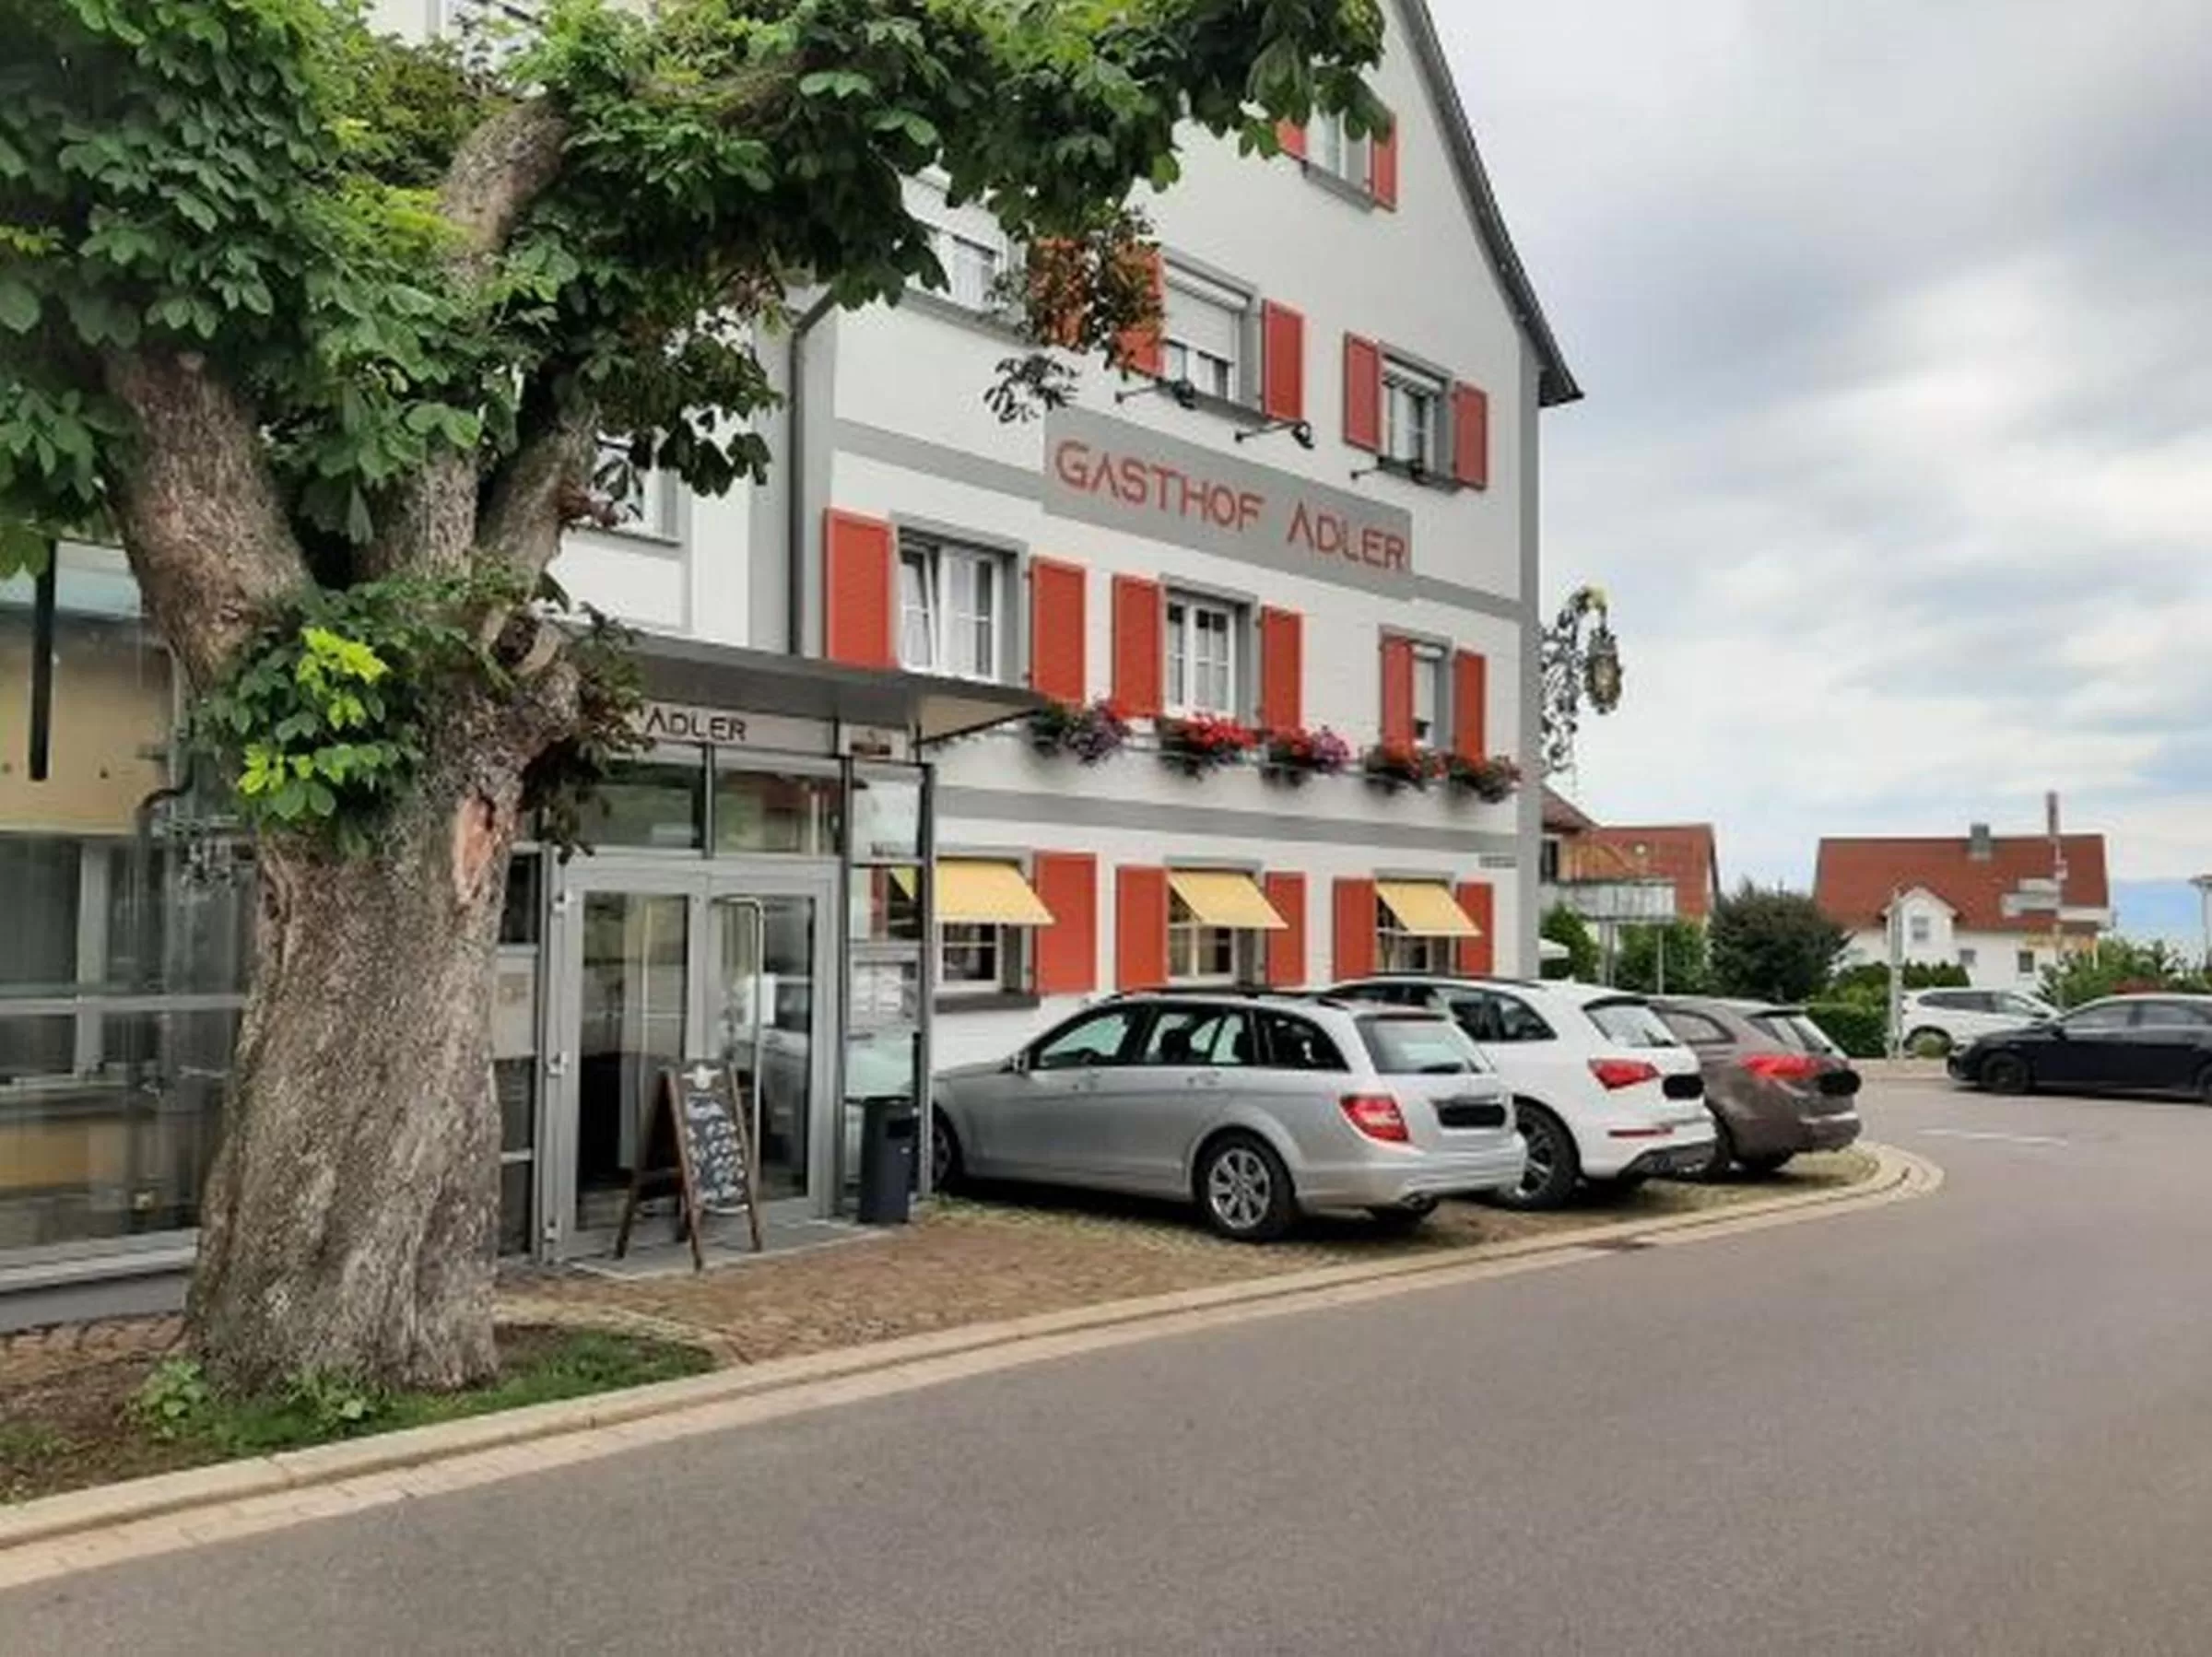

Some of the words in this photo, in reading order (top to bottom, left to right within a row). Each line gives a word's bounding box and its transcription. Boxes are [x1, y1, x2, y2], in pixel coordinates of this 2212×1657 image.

[1055, 440, 1265, 532] GASTHOF
[1288, 500, 1406, 570] ADLER
[646, 706, 747, 741] ADLER
